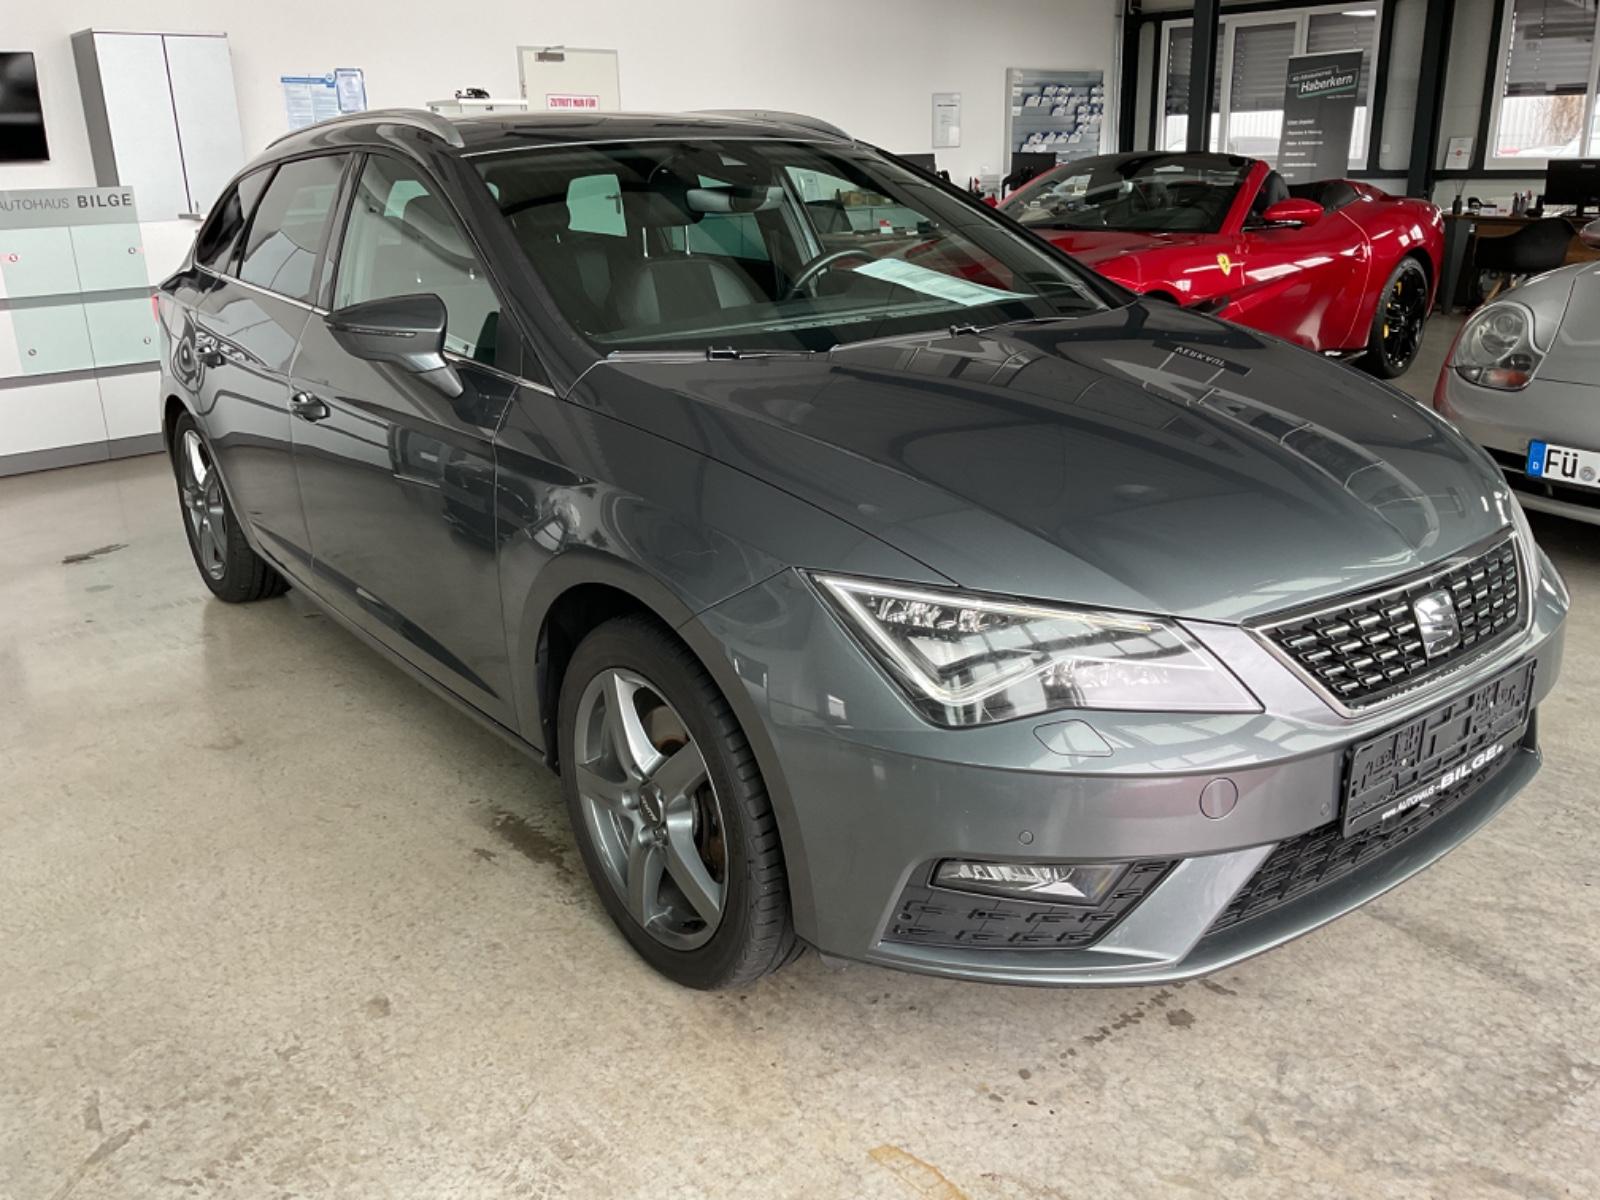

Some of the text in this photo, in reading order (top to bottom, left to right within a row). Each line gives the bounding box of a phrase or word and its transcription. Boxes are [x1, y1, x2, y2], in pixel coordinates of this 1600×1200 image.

[1300, 74, 1353, 93] Haberkern
[550, 98, 572, 107] ZUTRITT
[573, 98, 584, 107] NUR
[77, 193, 133, 209] BILGE
[1532, 461, 1539, 470] D
